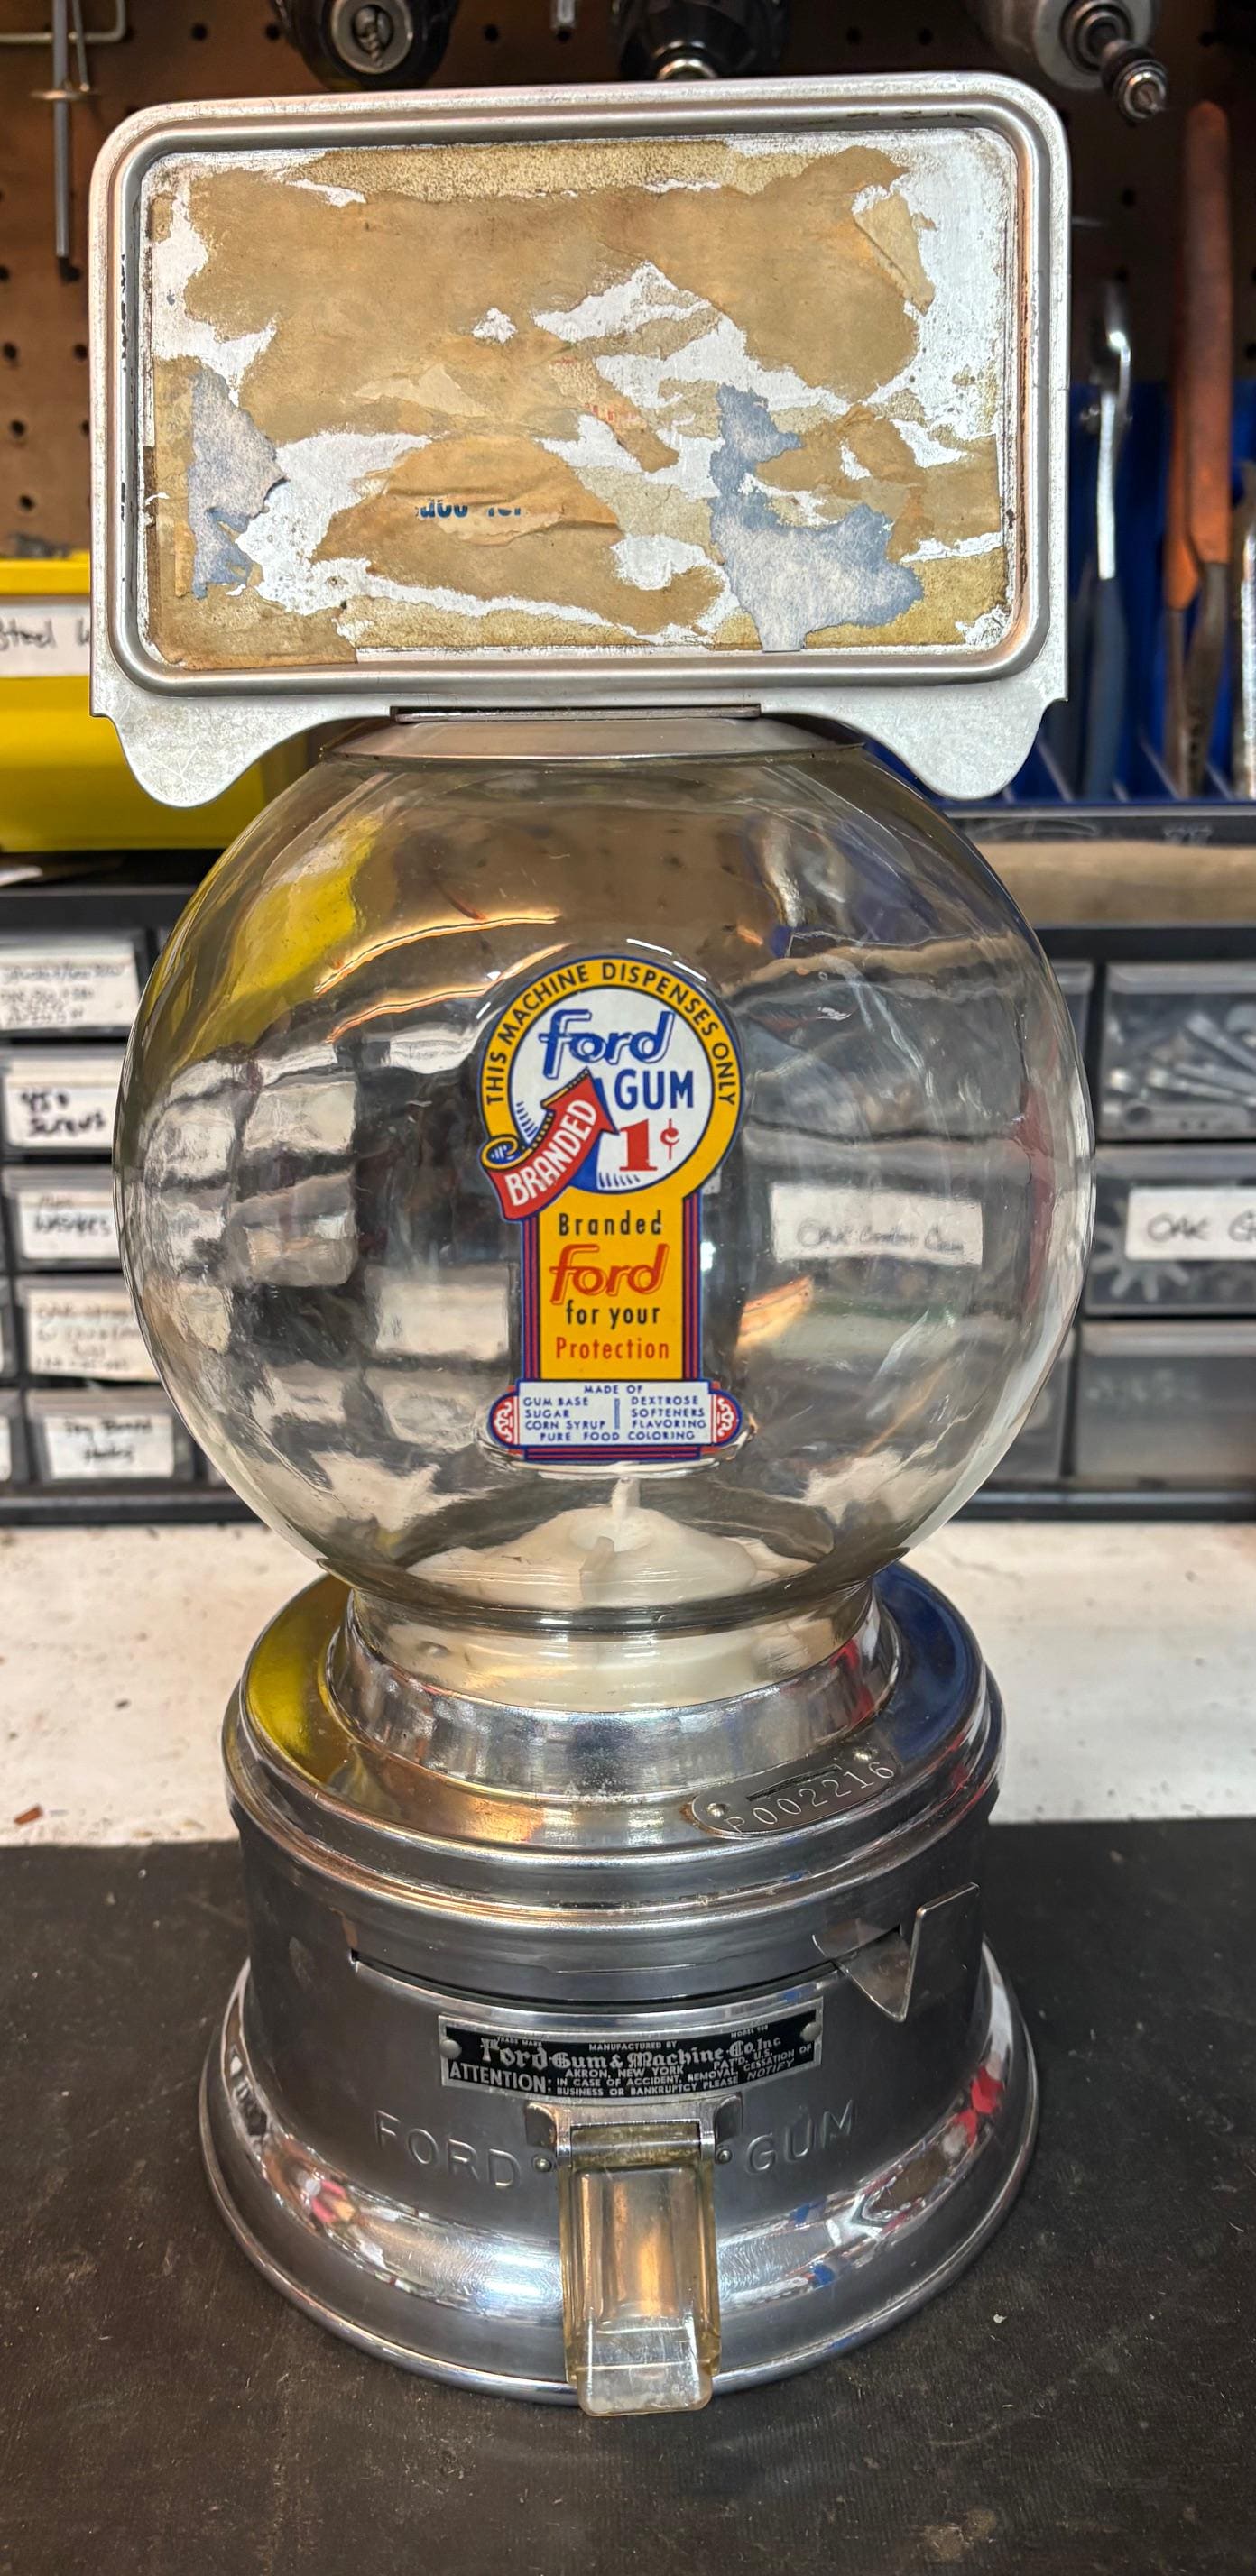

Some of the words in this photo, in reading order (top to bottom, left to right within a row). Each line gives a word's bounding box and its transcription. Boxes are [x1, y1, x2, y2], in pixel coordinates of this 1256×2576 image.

[496, 964, 590, 1046] MACHINE
[601, 961, 719, 1037] DISPENSES
[486, 1051, 507, 1106] THIS
[711, 1042, 736, 1106] ONLY
[614, 1069, 694, 1110] GUM
[503, 1099, 598, 1207] BRANDED
[559, 1210, 663, 1237] Branded
[567, 1300, 600, 1325] for
[610, 1306, 660, 1329] your
[556, 1336, 670, 1359] Protection
[523, 1396, 553, 1407] GUM
[558, 1396, 589, 1406] BASE
[584, 1385, 619, 1394] MADE
[626, 1385, 643, 1394] OF
[631, 1395, 698, 1406] DEXTROSE
[524, 1409, 570, 1419] SUGAR
[525, 1421, 559, 1431] CORN
[565, 1420, 606, 1430] SYRUP
[631, 1408, 705, 1418] SOFTENERS
[633, 1419, 706, 1429] FLAVORING
[540, 1431, 571, 1441] PURE
[583, 1431, 620, 1441] FOOD
[627, 1431, 695, 1440] COLORING
[724, 1762, 894, 1835] P002216
[480, 2037, 549, 2071] Ford
[551, 2051, 607, 2069] Gum
[609, 2053, 624, 2069] &
[626, 2046, 724, 2069] Machine
[589, 2041, 661, 2051] MANUFACTURED
[666, 2040, 677, 2049] BY
[449, 2061, 552, 2093] ATTENTION:
[557, 2077, 568, 2086] IN
[573, 2078, 601, 2087] CASE
[606, 2077, 622, 2087] OF
[743, 2049, 795, 2071] CESSATION
[799, 2044, 812, 2055] OF
[557, 2087, 604, 2096] BUSINESS
[609, 2087, 624, 2096] OR
[630, 2083, 697, 2096] BANKRUPTCY
[703, 2075, 739, 2090] PLEASE
[747, 2057, 795, 2081] NOTIFY
[618, 2067, 645, 2078] NEW
[651, 2065, 684, 2076] YORK
[374, 2109, 522, 2189] FORD
[744, 2099, 856, 2172] GUM
